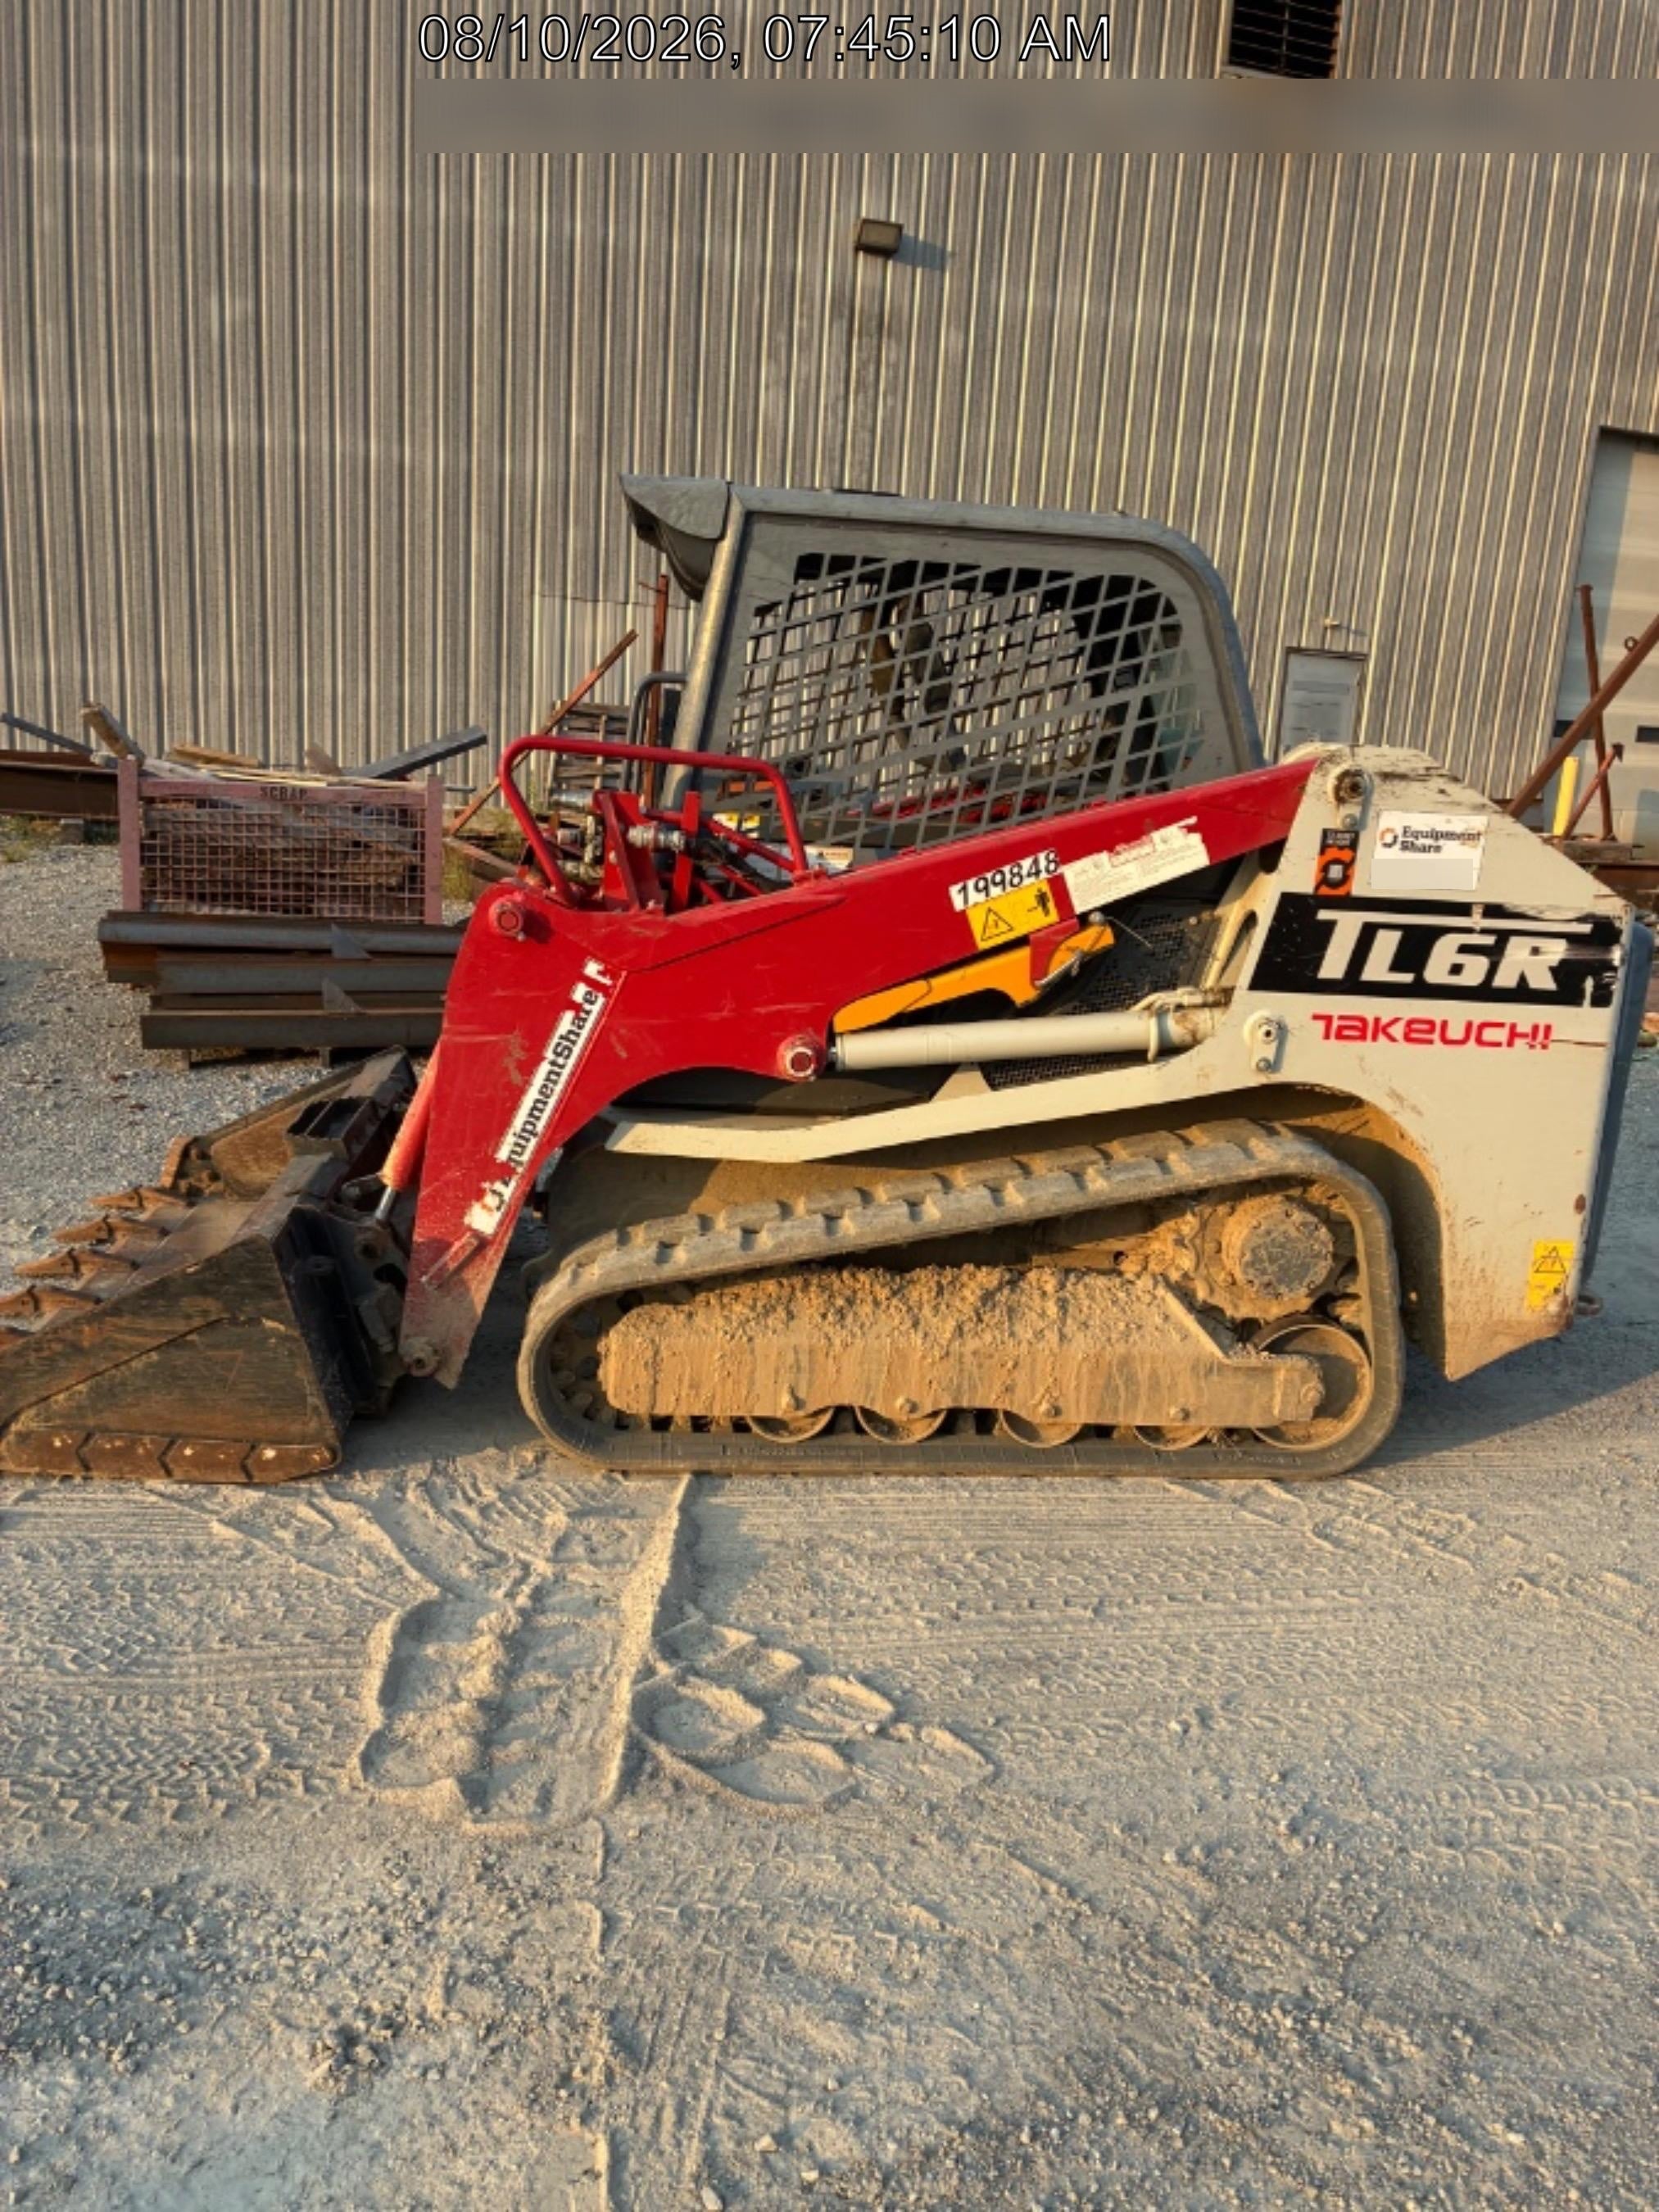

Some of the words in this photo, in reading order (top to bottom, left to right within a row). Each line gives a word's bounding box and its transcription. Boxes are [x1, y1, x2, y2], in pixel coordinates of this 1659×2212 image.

[260, 786, 308, 800] SCRAP
[1401, 826, 1482, 842] Equipment
[1399, 841, 1443, 854] Share
[957, 850, 1059, 907] 199848
[1316, 909, 1593, 991] TL6R
